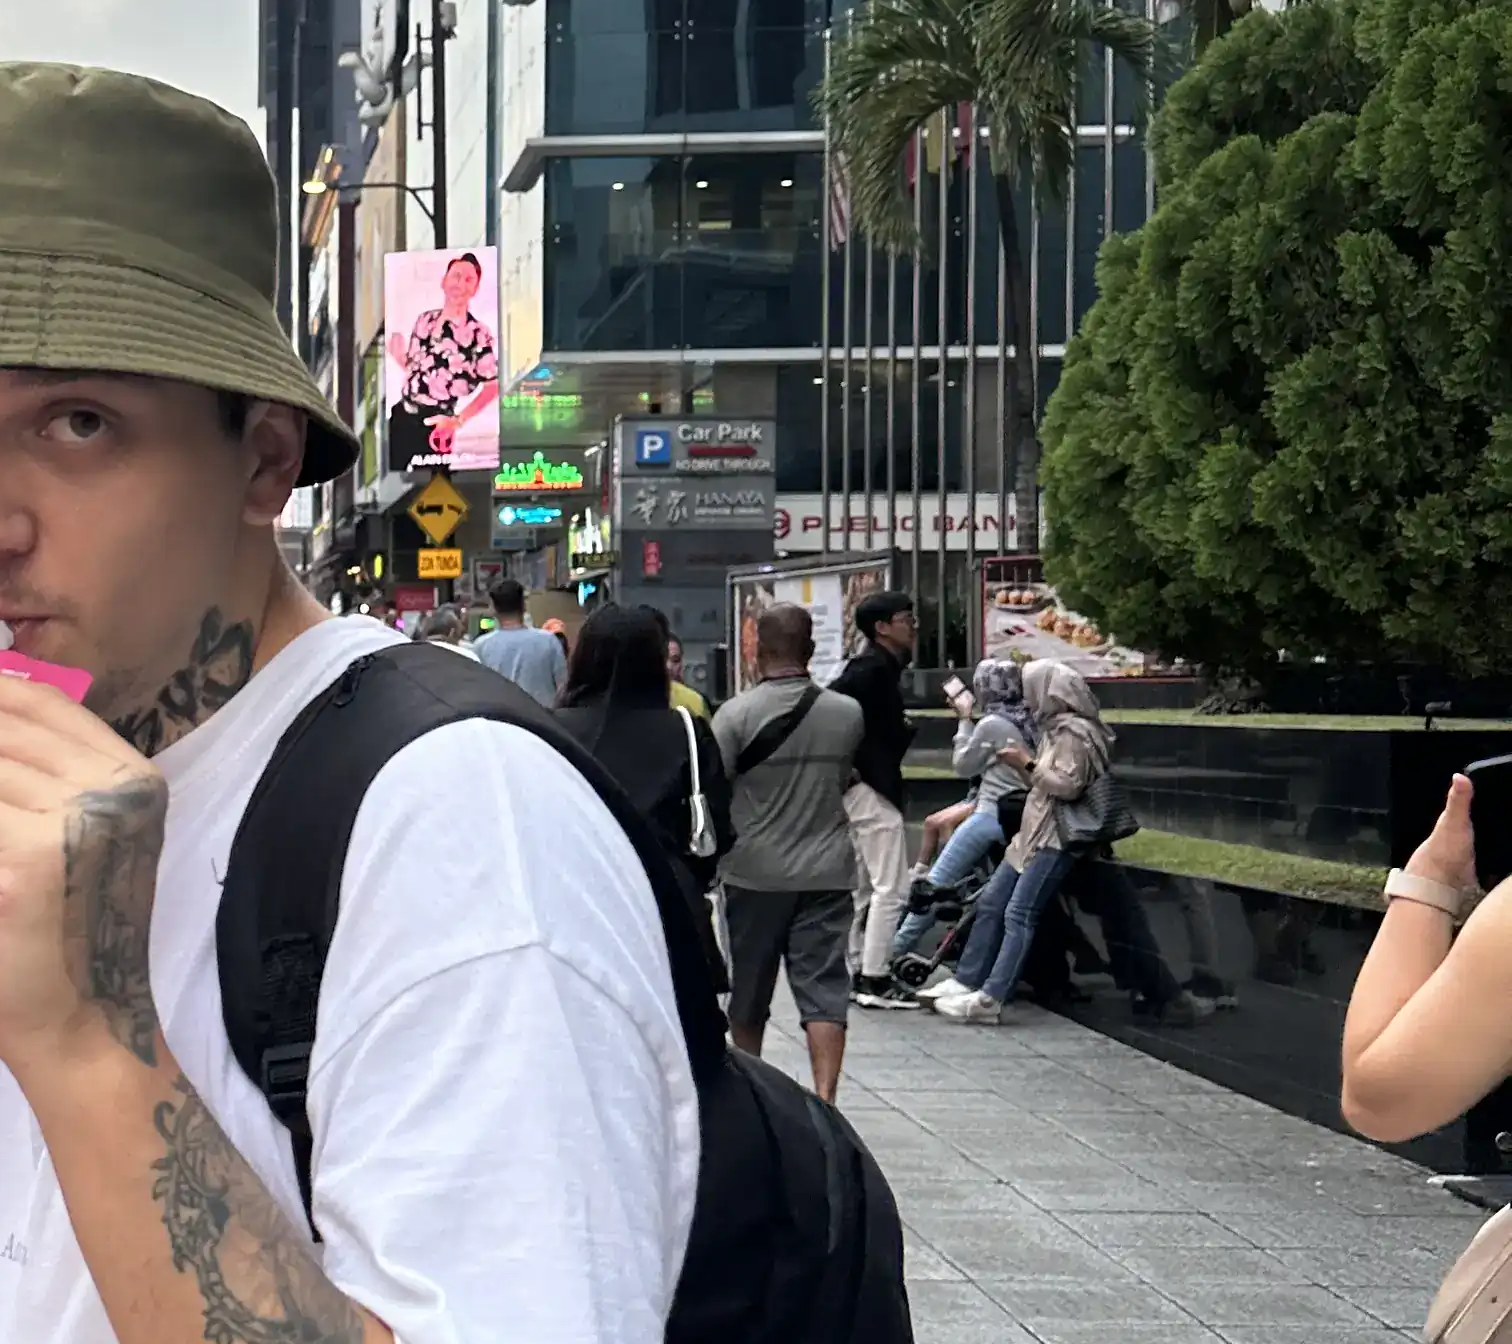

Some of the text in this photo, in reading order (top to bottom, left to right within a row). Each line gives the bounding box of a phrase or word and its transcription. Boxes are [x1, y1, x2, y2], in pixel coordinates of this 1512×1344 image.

[677, 423, 714, 441] Car
[718, 423, 763, 441] Park
[695, 490, 766, 506] HANAYA
